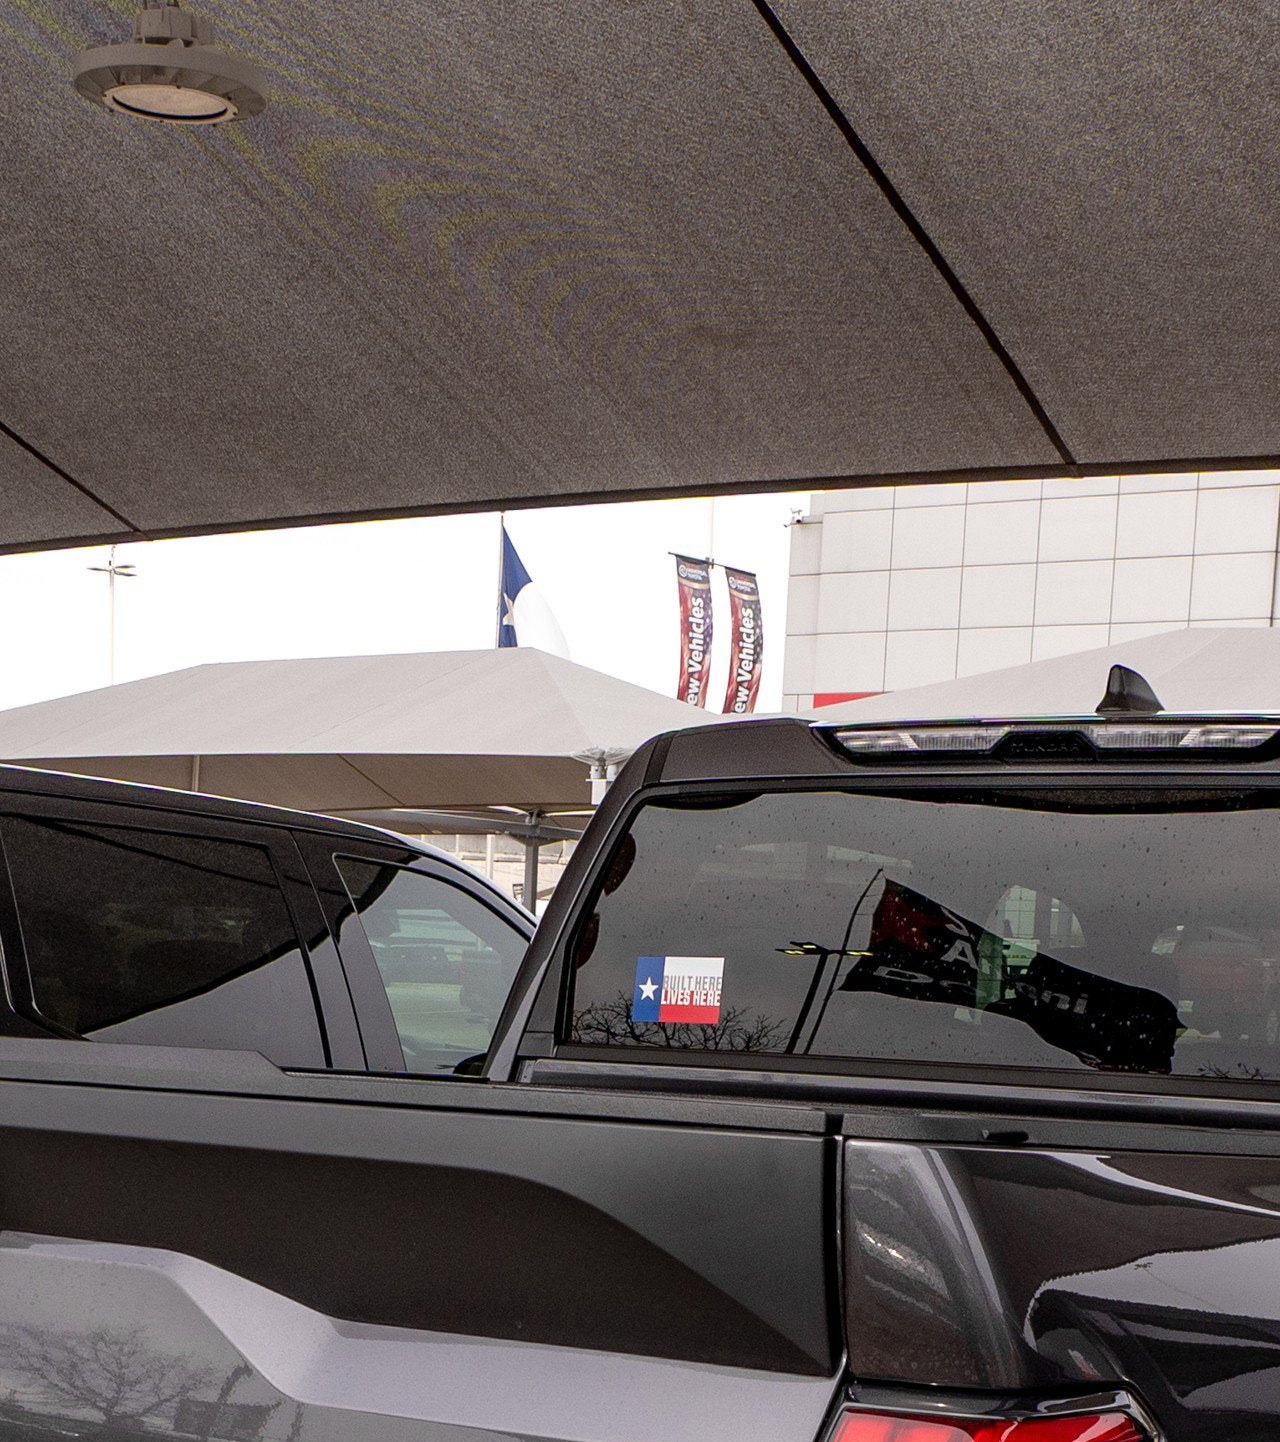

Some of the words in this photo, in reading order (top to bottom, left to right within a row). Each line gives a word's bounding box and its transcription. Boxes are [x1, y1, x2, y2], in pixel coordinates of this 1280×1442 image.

[688, 597, 704, 674] Vehicles
[737, 607, 755, 684] Vehicles
[687, 681, 701, 705] ew
[734, 688, 749, 713] ew
[663, 976, 693, 990] BUILT
[695, 976, 723, 991] HERE
[661, 989, 691, 1005] LIVES
[693, 990, 721, 1007] HERE
